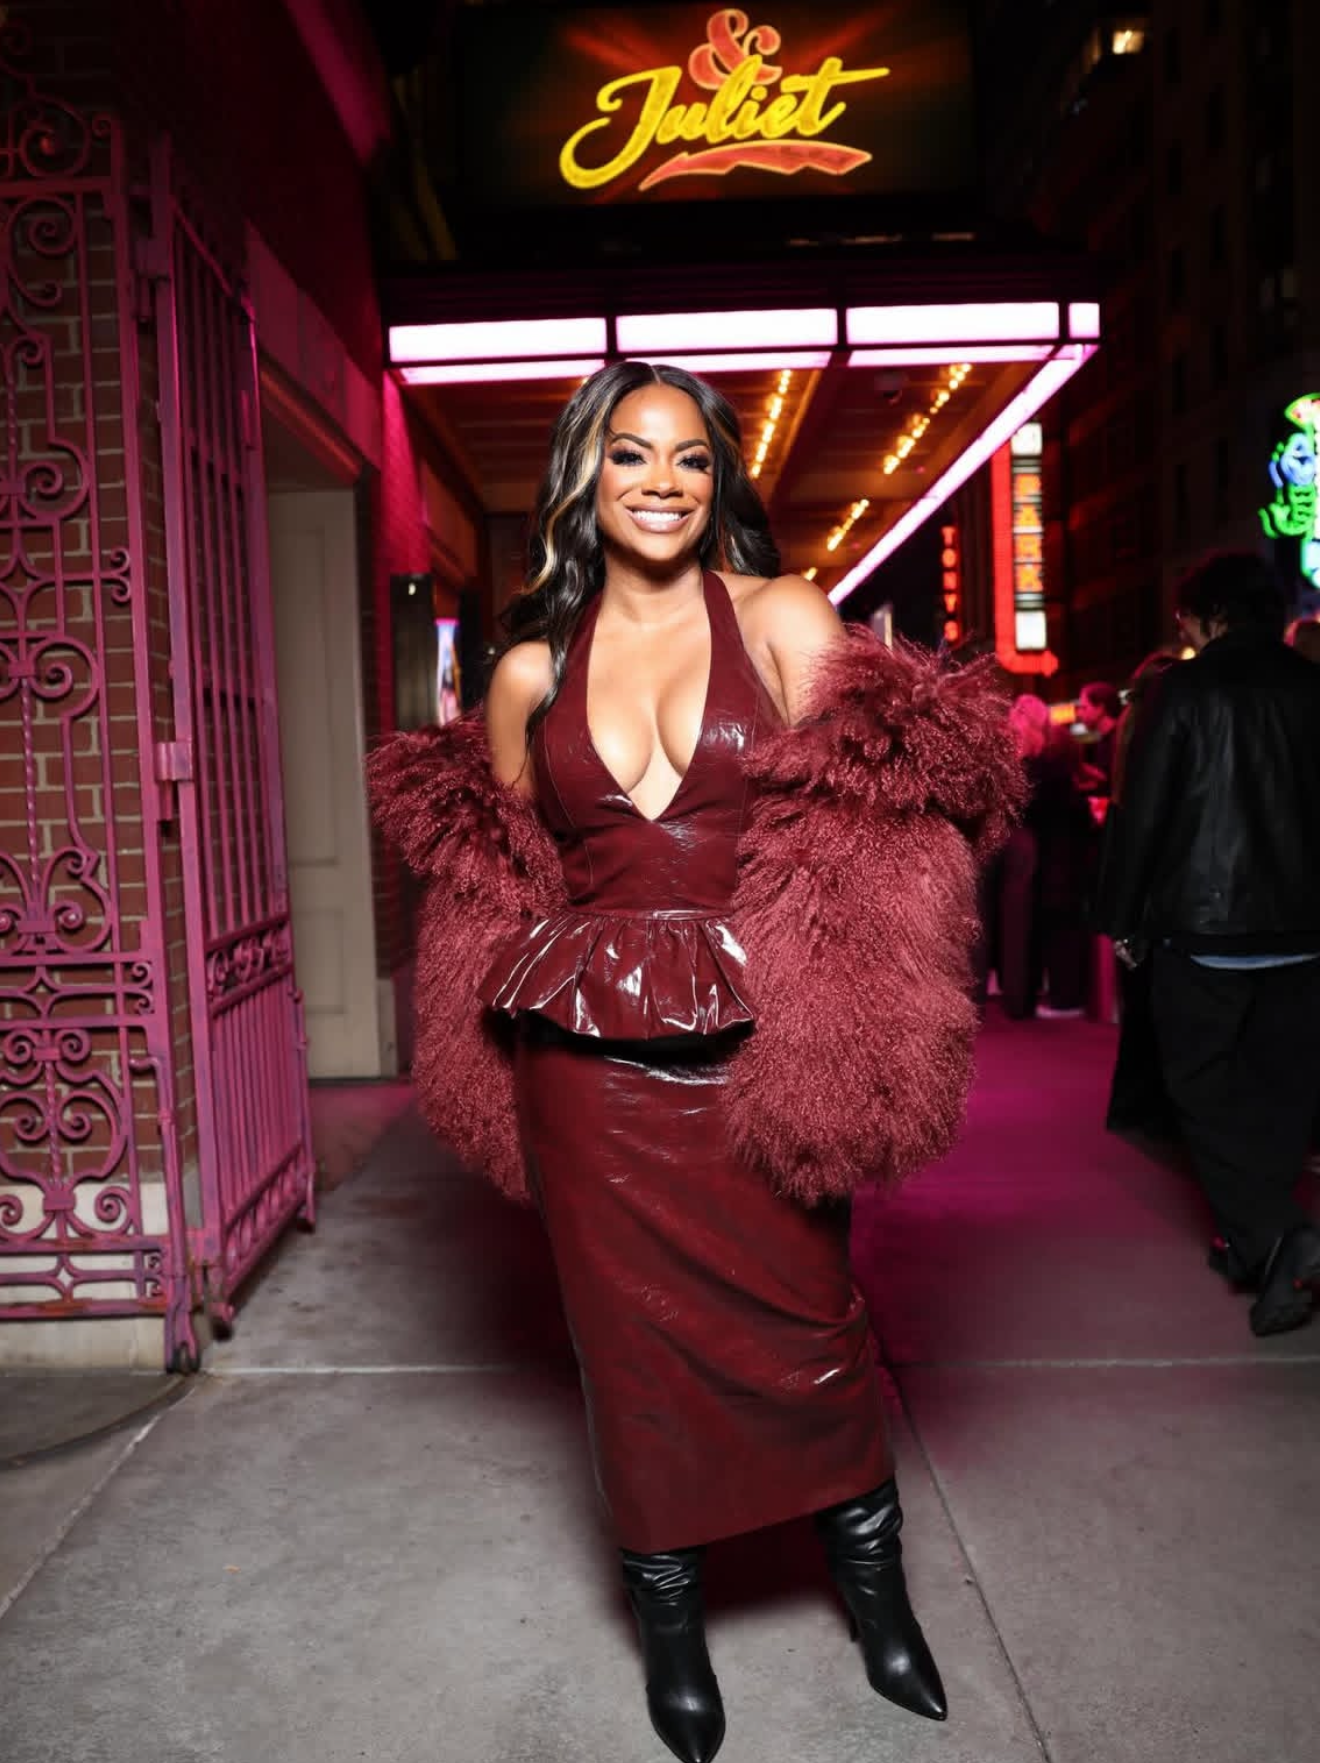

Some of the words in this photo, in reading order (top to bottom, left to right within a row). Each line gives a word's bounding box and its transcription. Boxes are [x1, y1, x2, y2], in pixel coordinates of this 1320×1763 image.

[688, 8, 783, 90] &
[559, 54, 890, 189] Juliet
[1014, 474, 1042, 592] PARK
